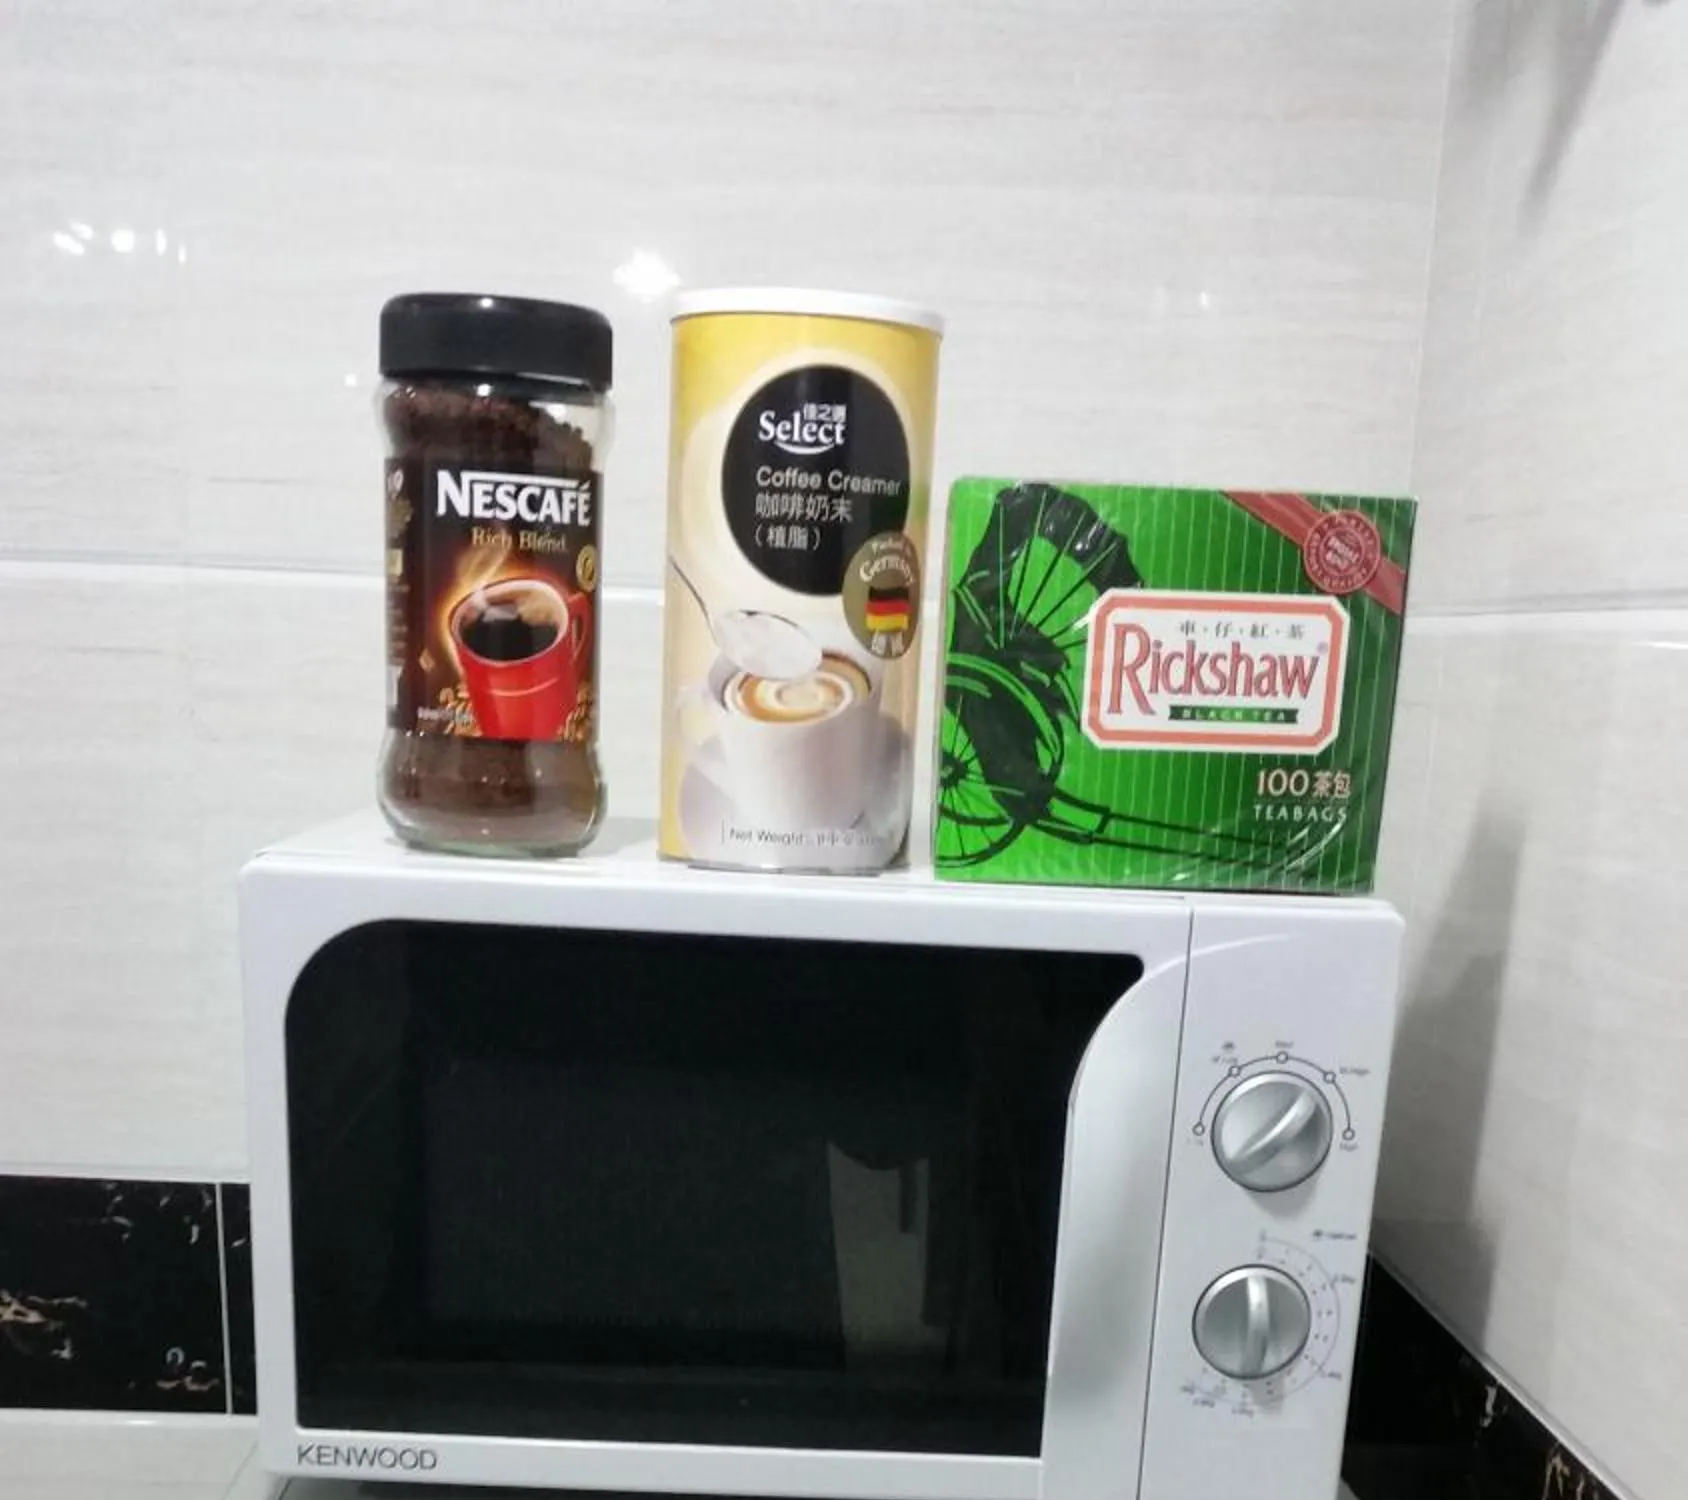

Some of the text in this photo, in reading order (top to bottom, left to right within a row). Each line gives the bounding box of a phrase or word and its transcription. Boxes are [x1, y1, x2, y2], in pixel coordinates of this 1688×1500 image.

[758, 409, 846, 445] Select
[755, 464, 902, 497] Coffee Creamer
[436, 469, 592, 528] NESCAFÉ
[471, 525, 567, 555] Rich Blend
[1106, 622, 1320, 717] Rickshaw
[1253, 803, 1348, 824] TEABAGS
[296, 1443, 438, 1470] KENWOOD
